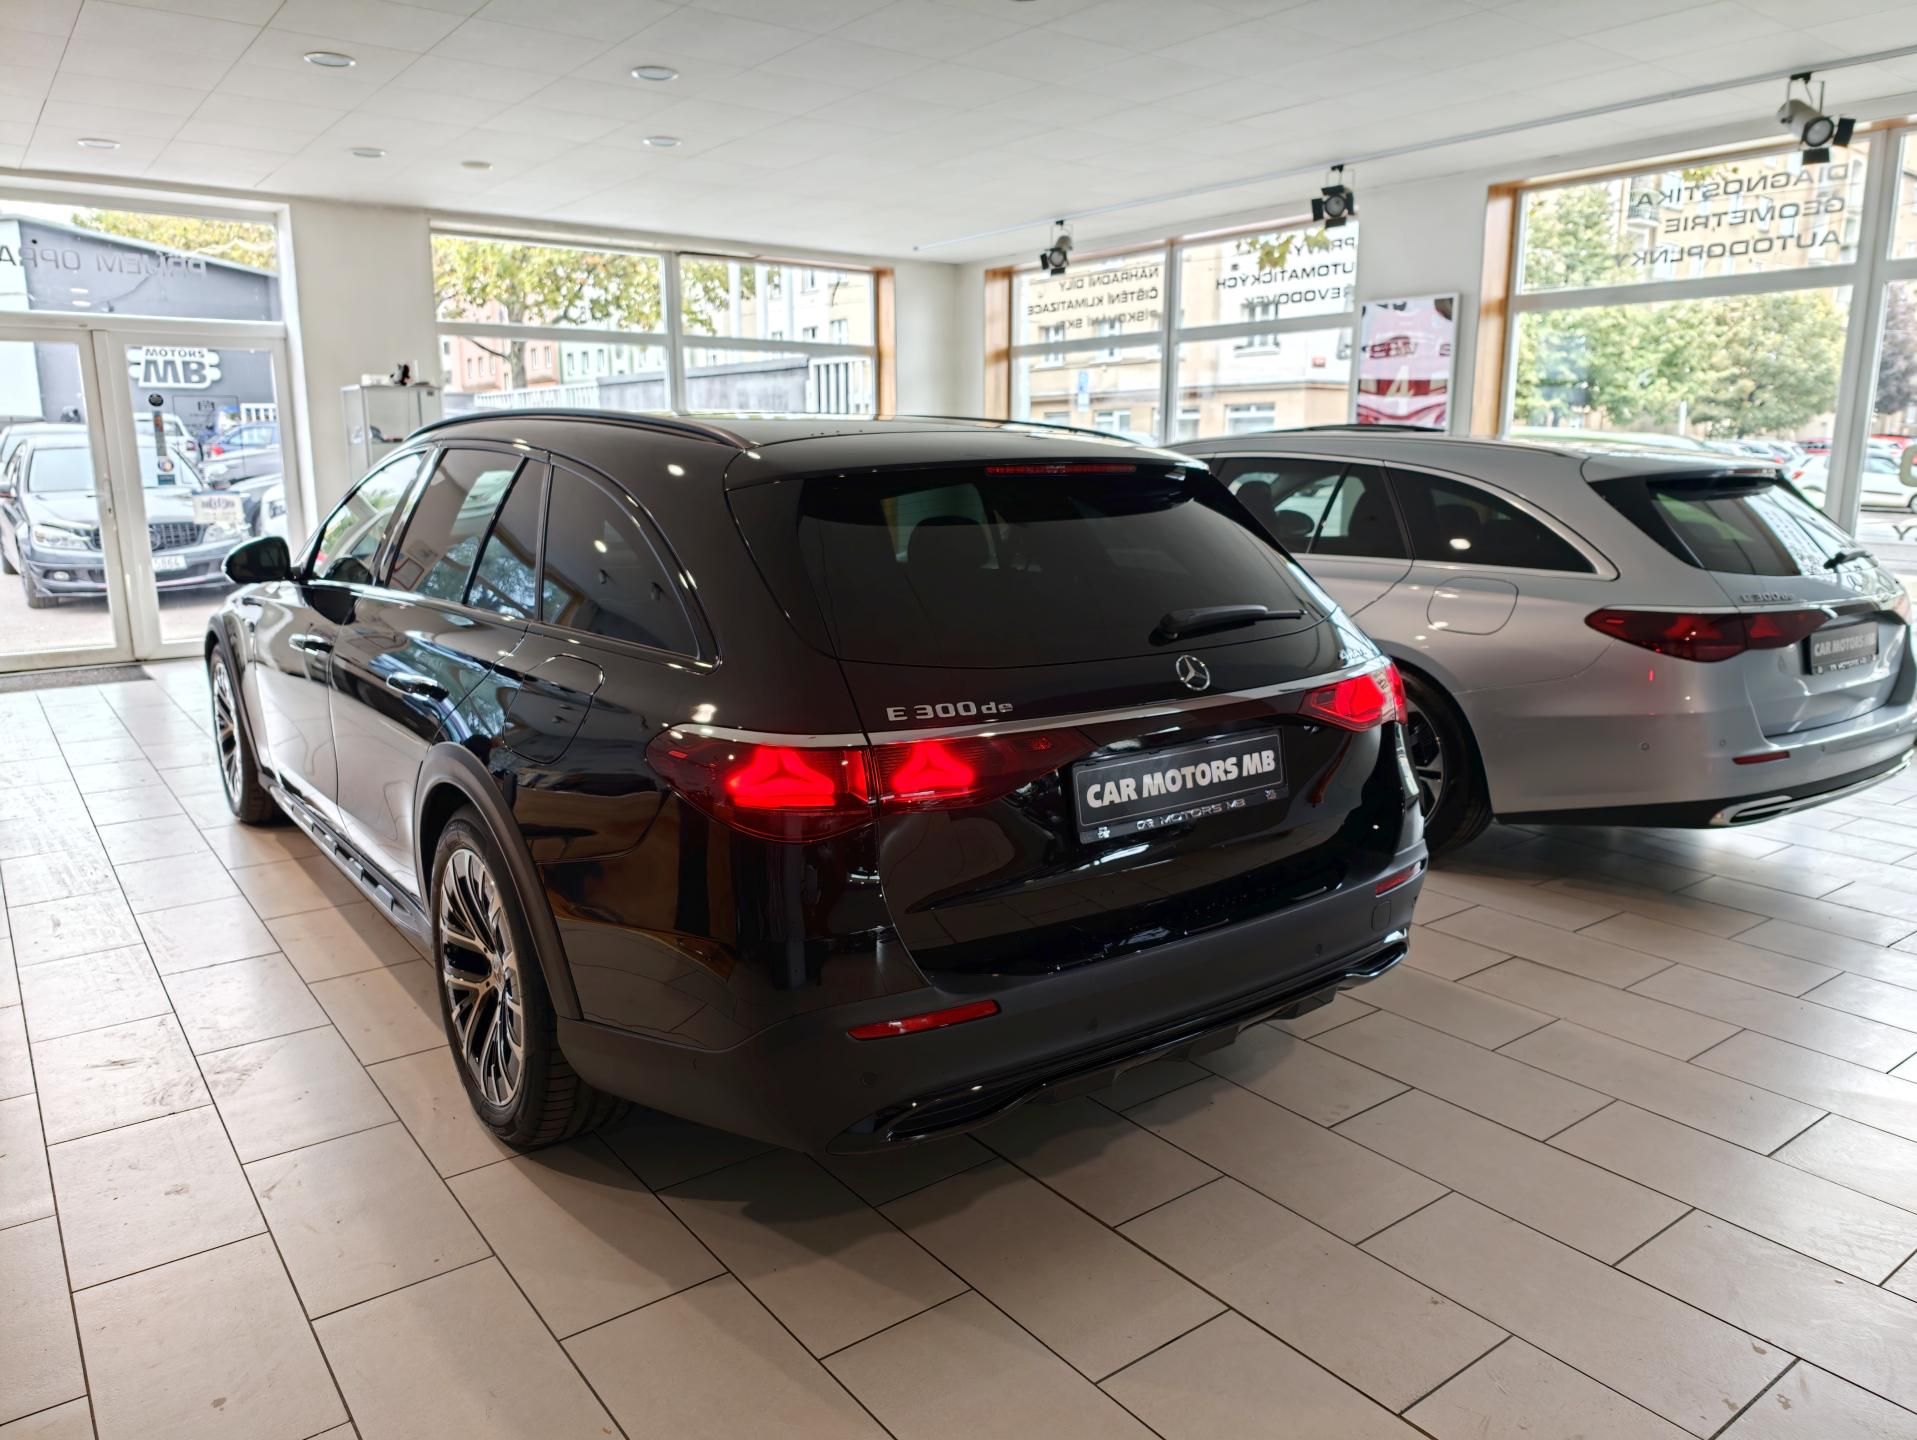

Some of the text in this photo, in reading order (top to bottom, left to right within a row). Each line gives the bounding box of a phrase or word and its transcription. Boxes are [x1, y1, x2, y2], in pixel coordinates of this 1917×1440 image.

[145, 348, 205, 358] MOTORS
[143, 359, 207, 384] MB
[1814, 642, 1831, 657] CAR
[886, 701, 1014, 721] E 300 de
[1086, 750, 1275, 808] CAR MOTORS MB
[1160, 804, 1223, 825] MOTORS
[1227, 798, 1246, 809] MB
